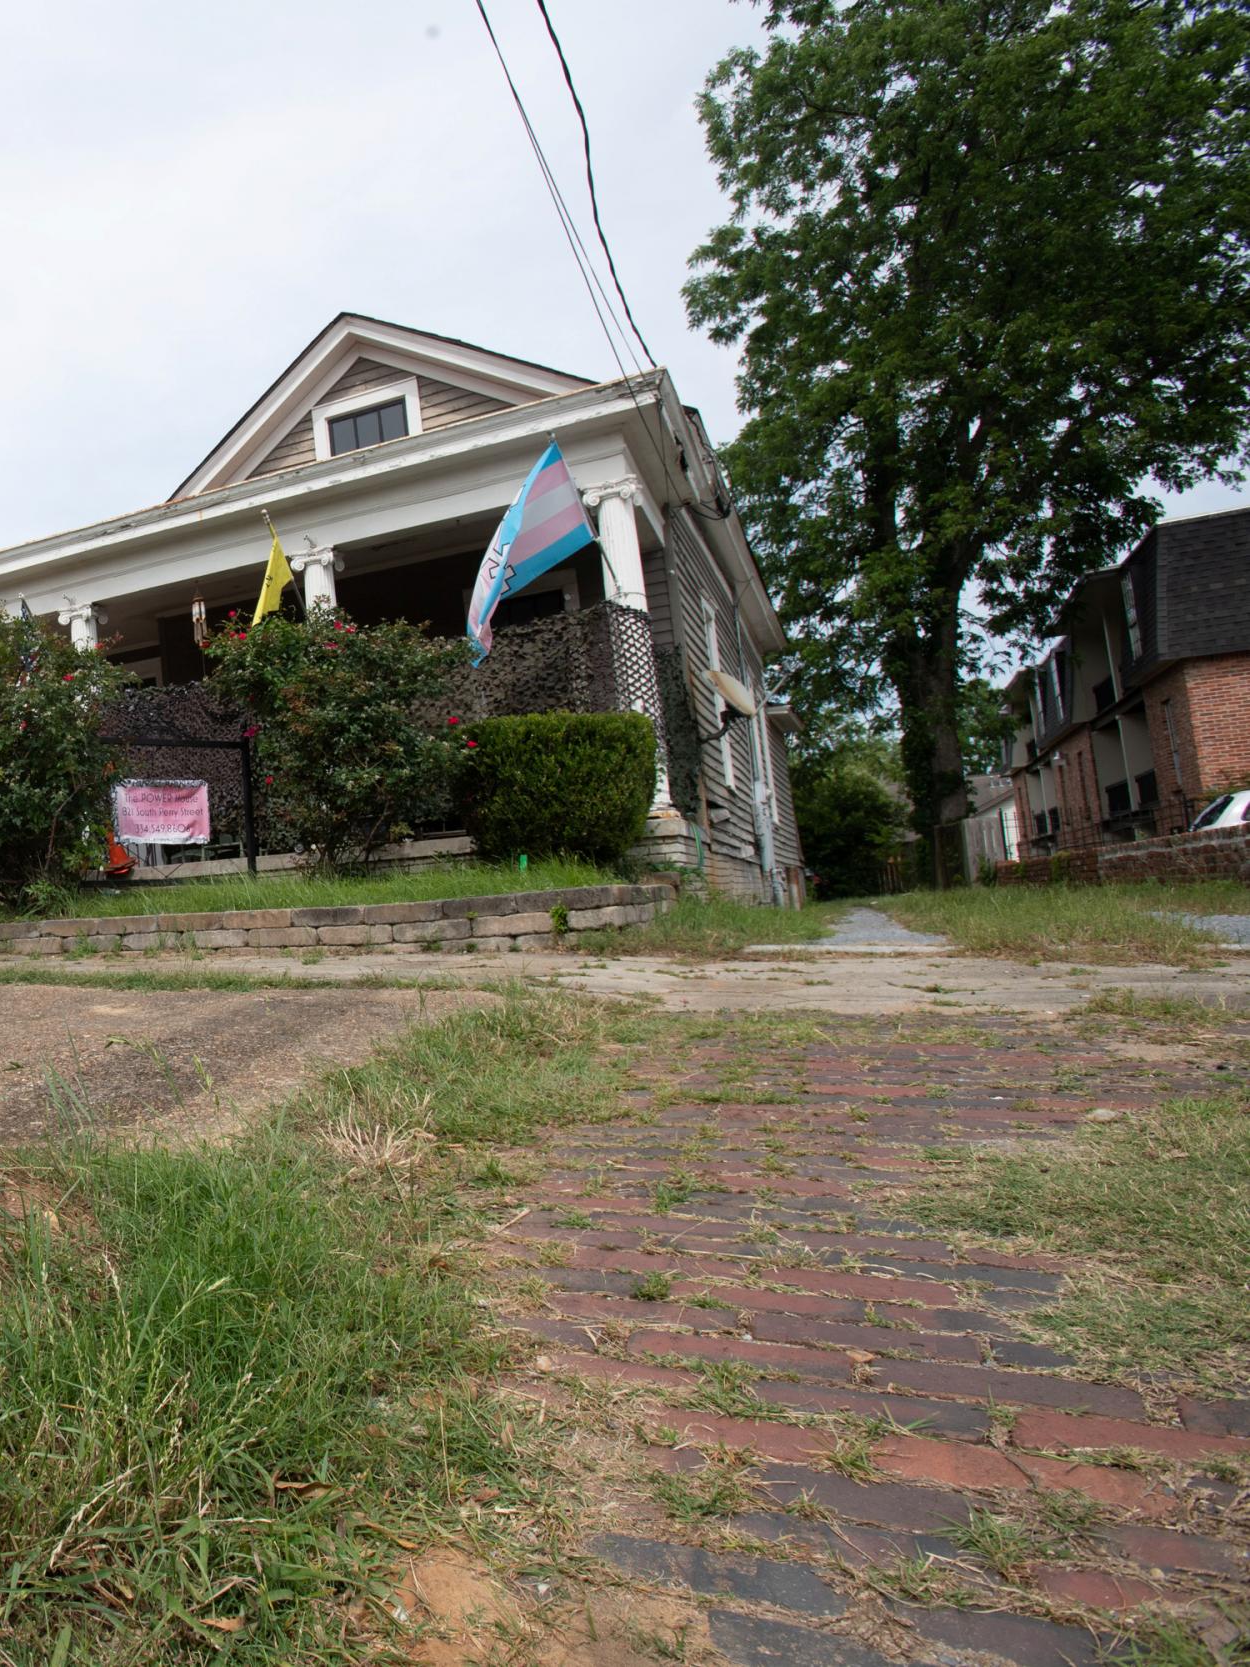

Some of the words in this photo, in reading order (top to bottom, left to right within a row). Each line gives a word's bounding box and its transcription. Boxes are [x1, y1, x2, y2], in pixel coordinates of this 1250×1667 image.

[125, 793, 139, 803] The
[141, 793, 172, 803] POWER
[122, 807, 134, 817] 821
[136, 807, 156, 816] South
[158, 807, 178, 818] Perry
[180, 807, 203, 816] Street
